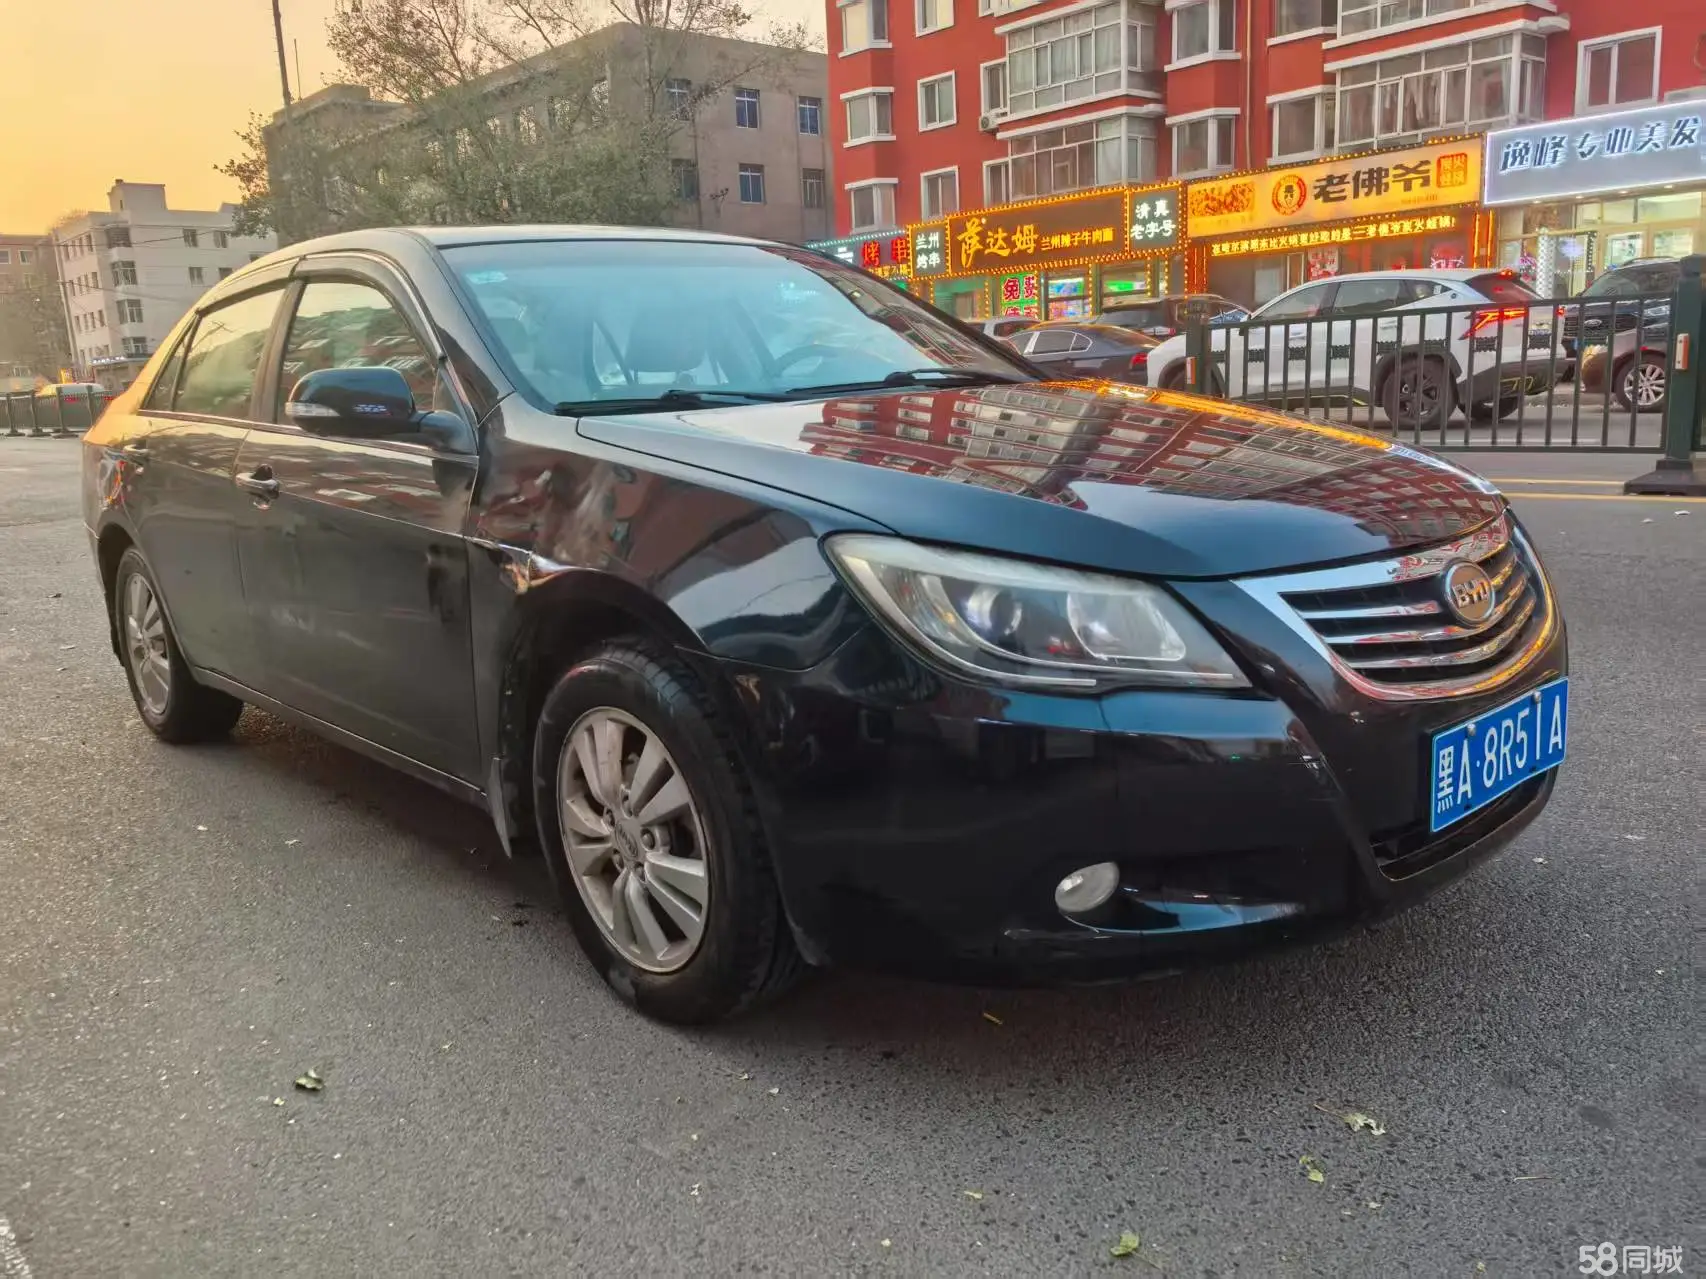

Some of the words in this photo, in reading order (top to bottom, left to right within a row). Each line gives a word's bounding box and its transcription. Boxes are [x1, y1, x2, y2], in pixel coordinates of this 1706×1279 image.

[1313, 159, 1433, 203] 老佛爷
[1135, 200, 1170, 219] 清真
[915, 231, 940, 250] 兰州
[957, 217, 1040, 269] 萨达姆
[1130, 219, 1176, 240] 老字号
[862, 237, 908, 267] 烤串
[1004, 275, 1036, 301] 免费
[1453, 577, 1490, 608] BYD
